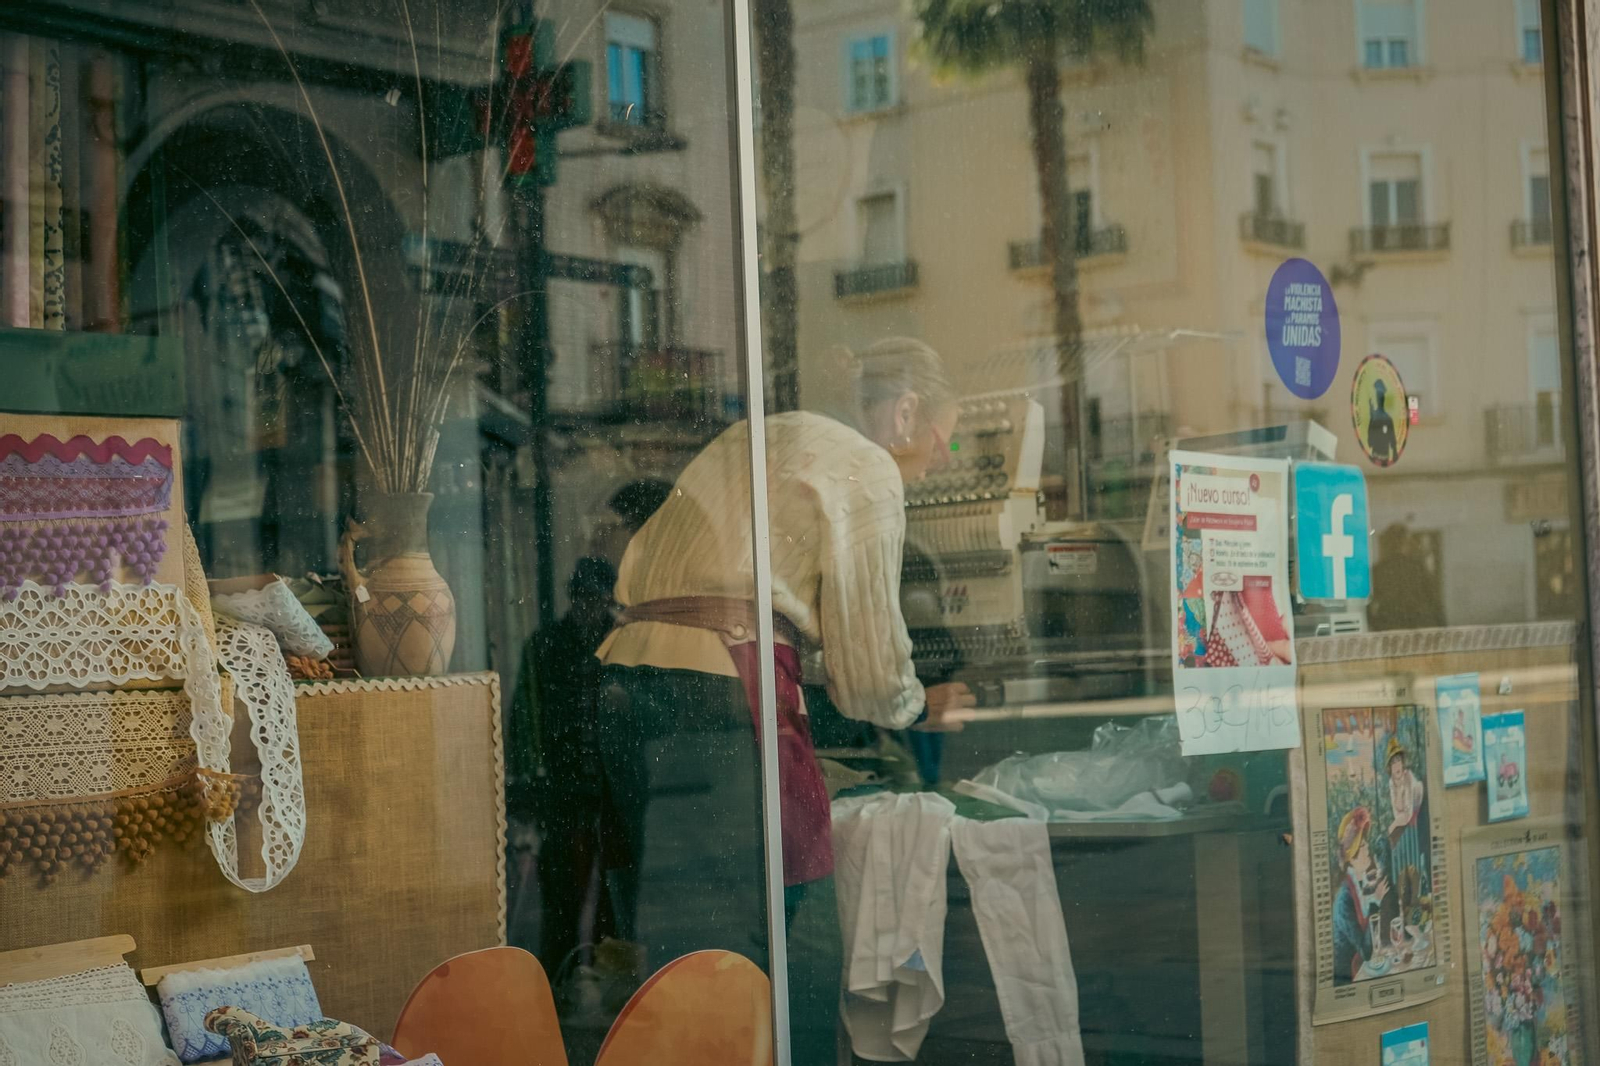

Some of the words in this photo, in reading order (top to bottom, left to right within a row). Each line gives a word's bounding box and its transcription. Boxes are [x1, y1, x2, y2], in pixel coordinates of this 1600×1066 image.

[1290, 283, 1321, 296] VIOLENCIA
[1284, 296, 1322, 312] MACHISTA
[1291, 311, 1320, 325] PARAMOS
[1282, 325, 1322, 347] UNIDAS
[1187, 482, 1219, 506] ¡Nuevo
[1222, 487, 1251, 506] curso!
